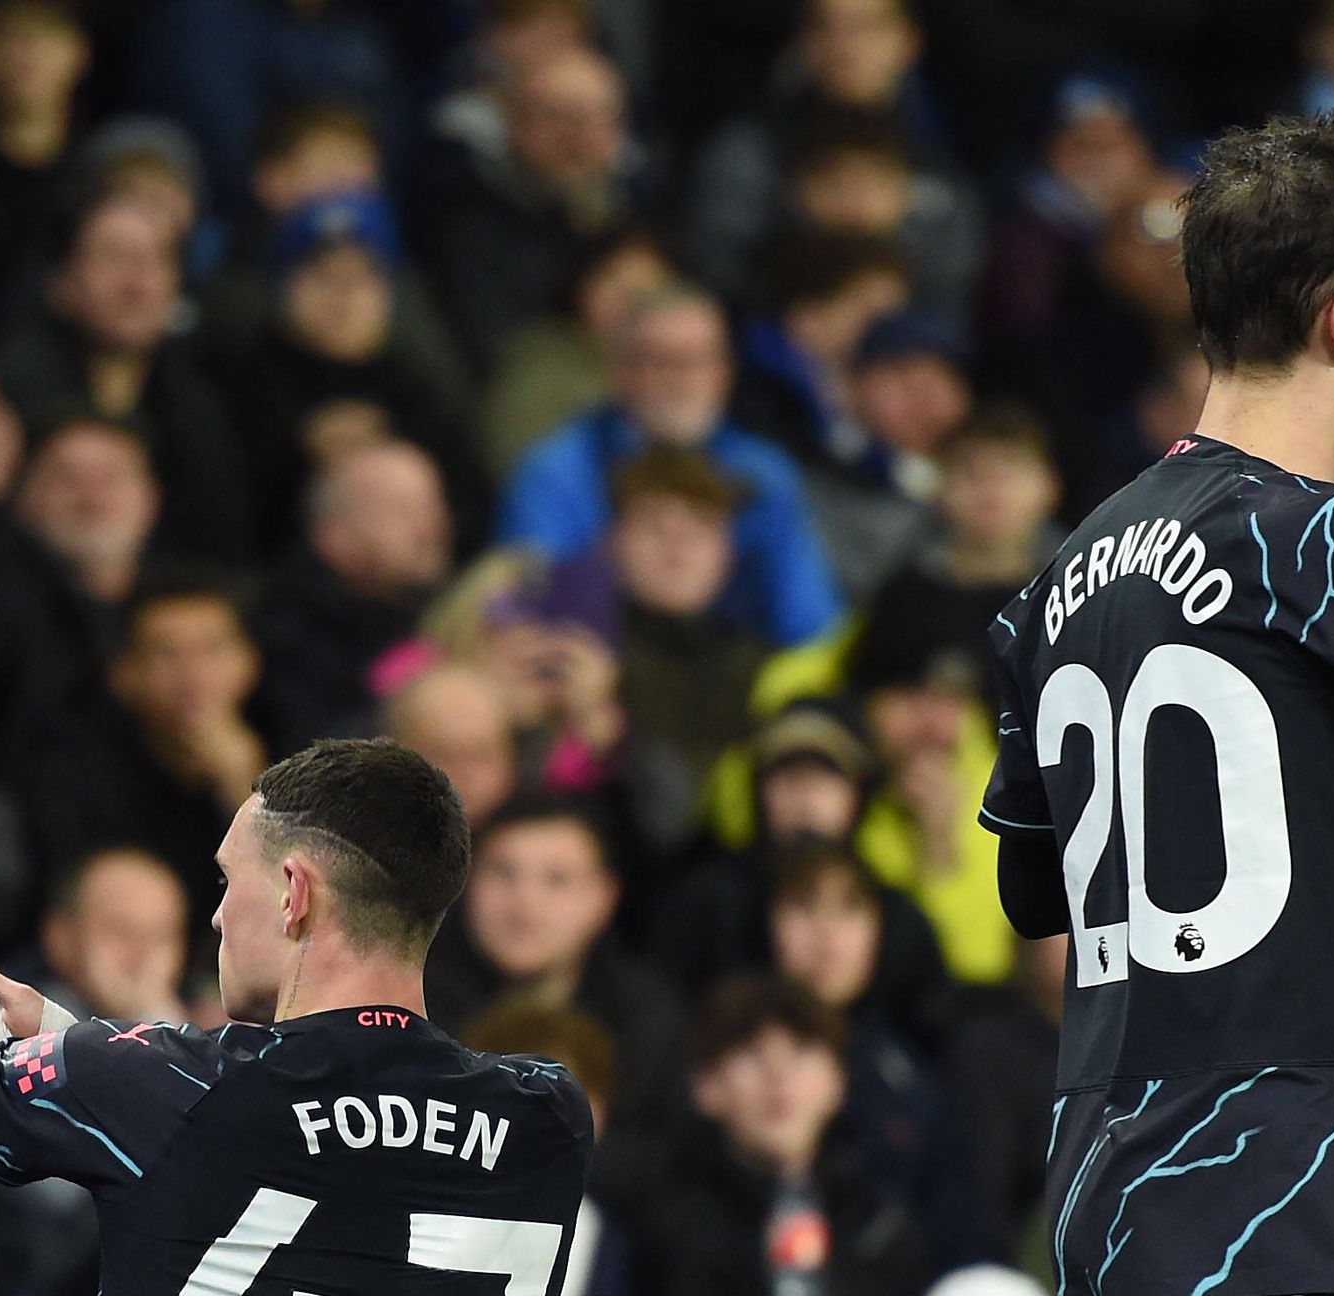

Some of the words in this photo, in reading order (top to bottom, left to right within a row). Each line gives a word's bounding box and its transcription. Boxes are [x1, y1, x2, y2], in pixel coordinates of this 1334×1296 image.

[1044, 517, 1233, 647] BERNARDO
[1036, 643, 1292, 988] 20
[357, 1011, 410, 1029] CITY
[291, 1094, 511, 1172] FODEN
